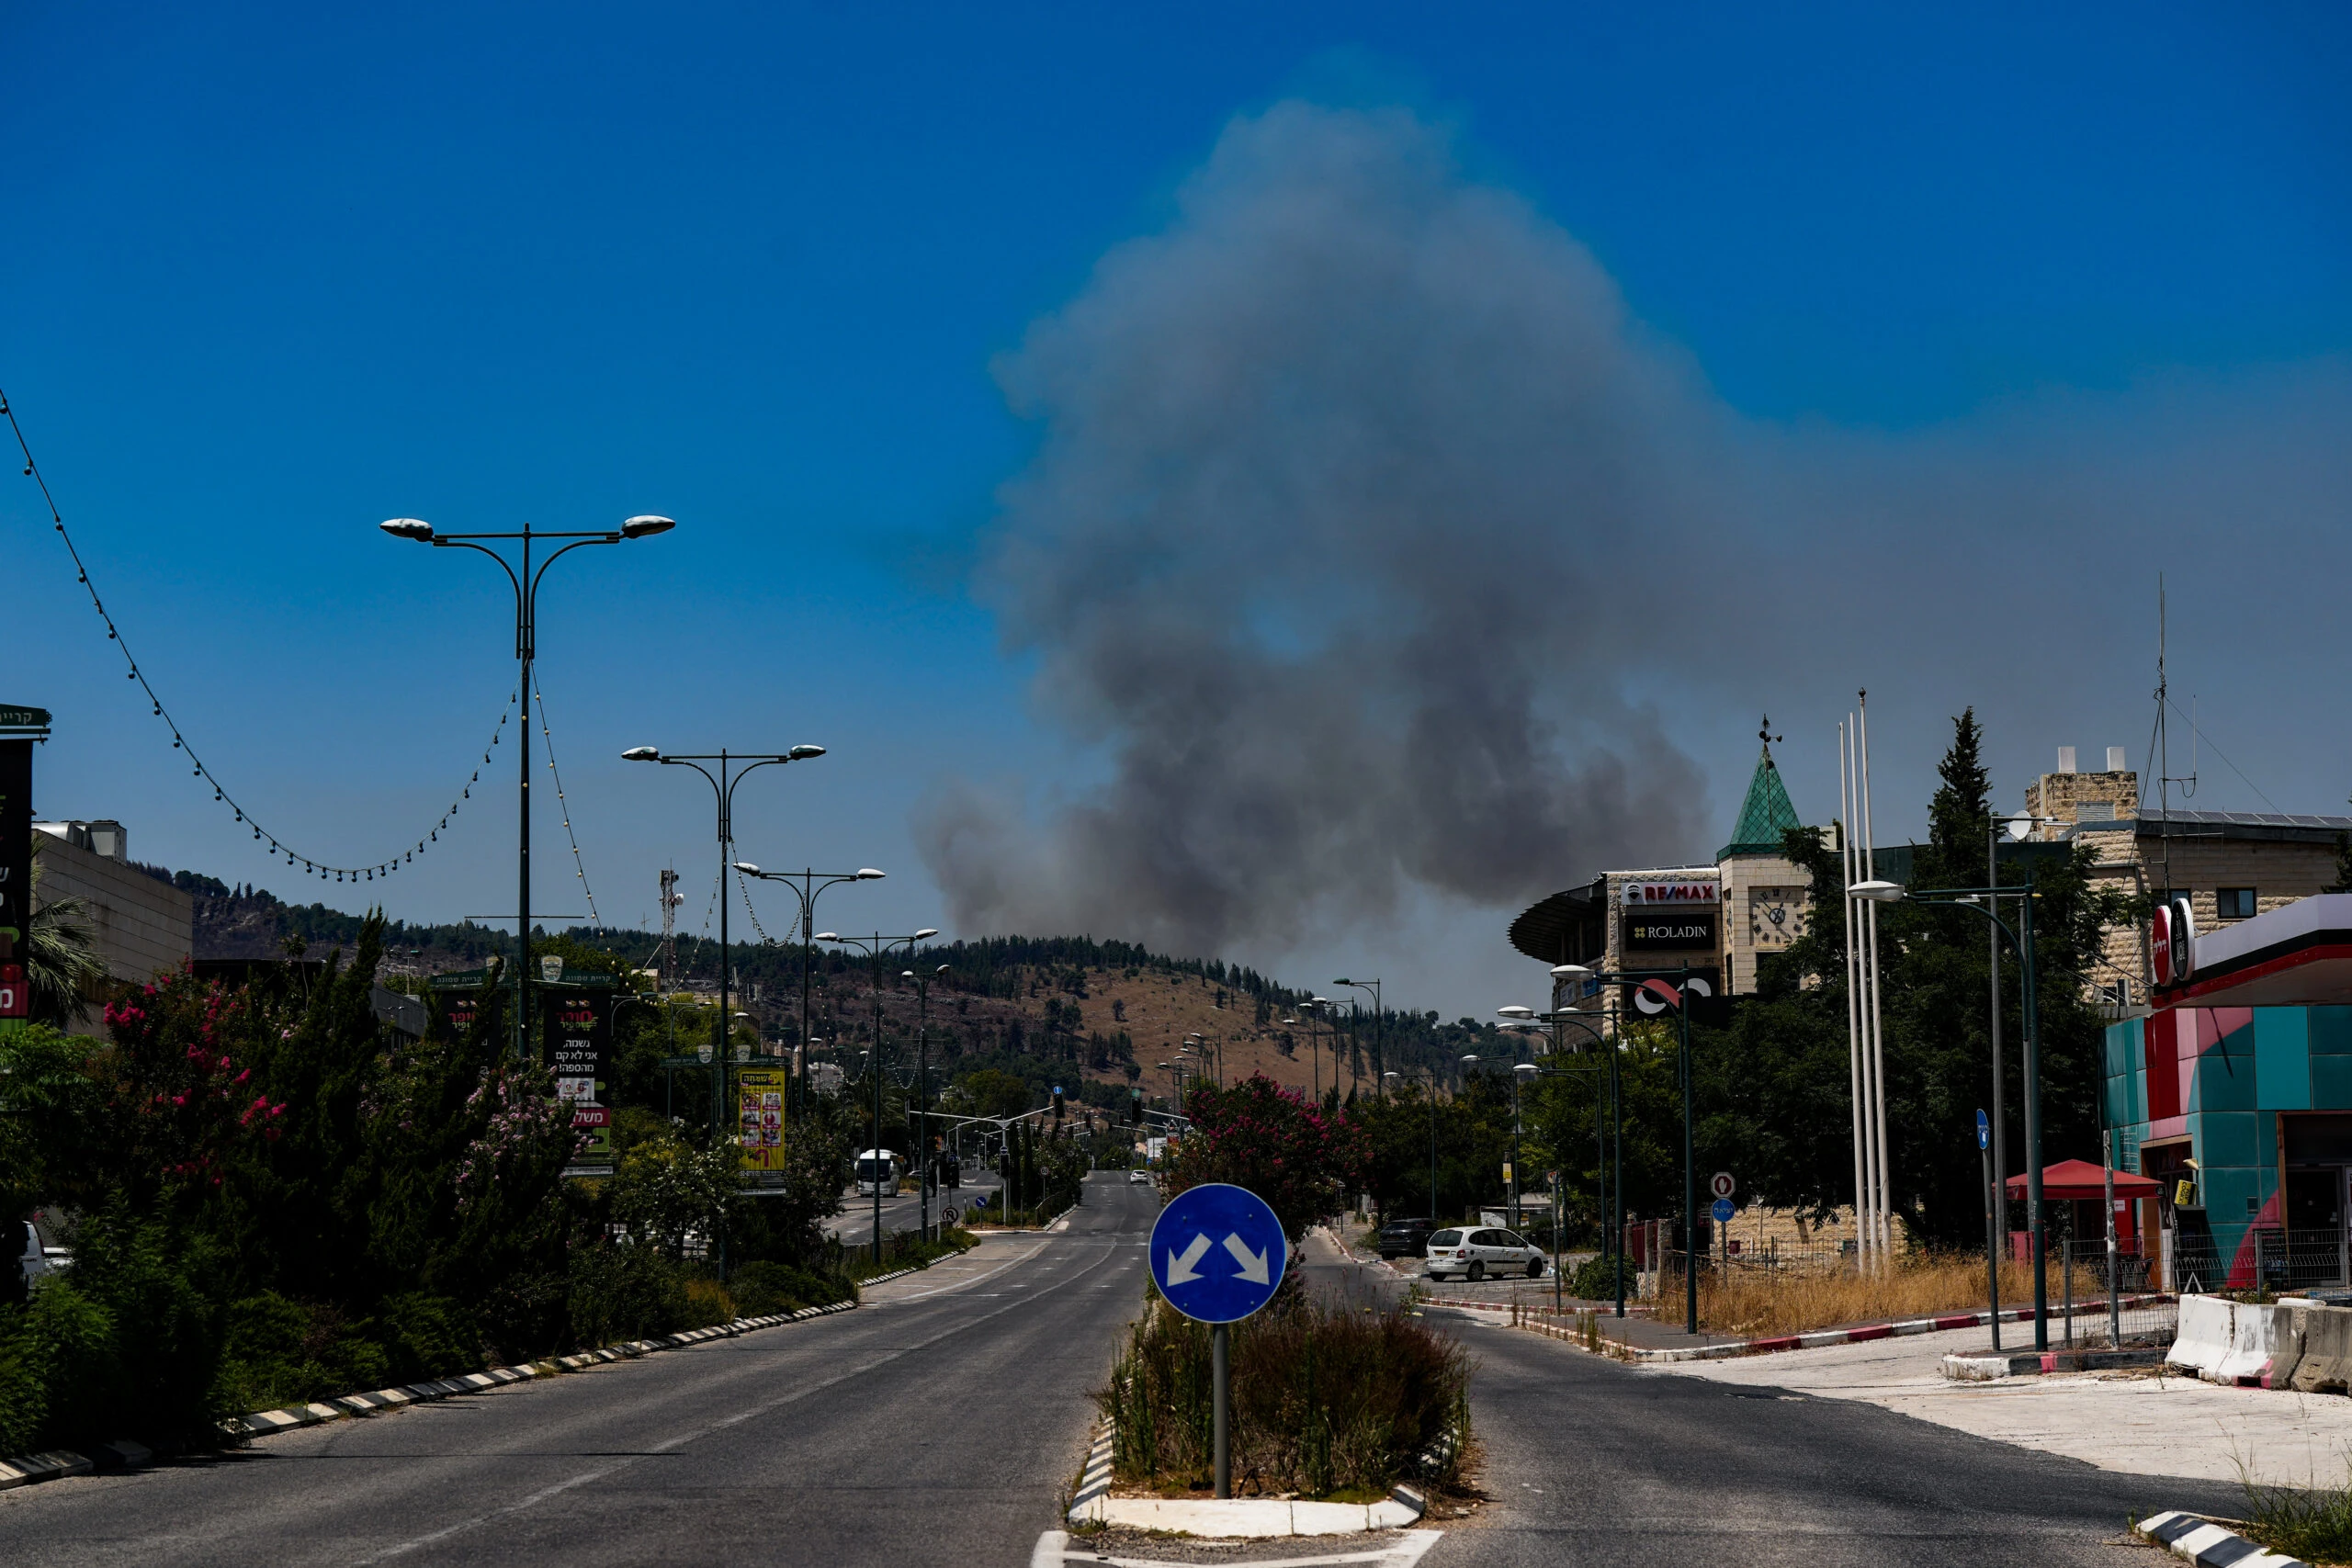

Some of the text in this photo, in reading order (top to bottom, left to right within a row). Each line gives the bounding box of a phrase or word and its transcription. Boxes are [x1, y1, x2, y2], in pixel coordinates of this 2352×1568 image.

[0, 712, 32, 725] קריי
[1645, 886, 1713, 900] RE/MAX
[1648, 926, 1707, 939] ROLADIN
[563, 1039, 591, 1048] נשמה,
[555, 1049, 598, 1063] אני לא קם
[559, 1064, 594, 1073] מהספה!
